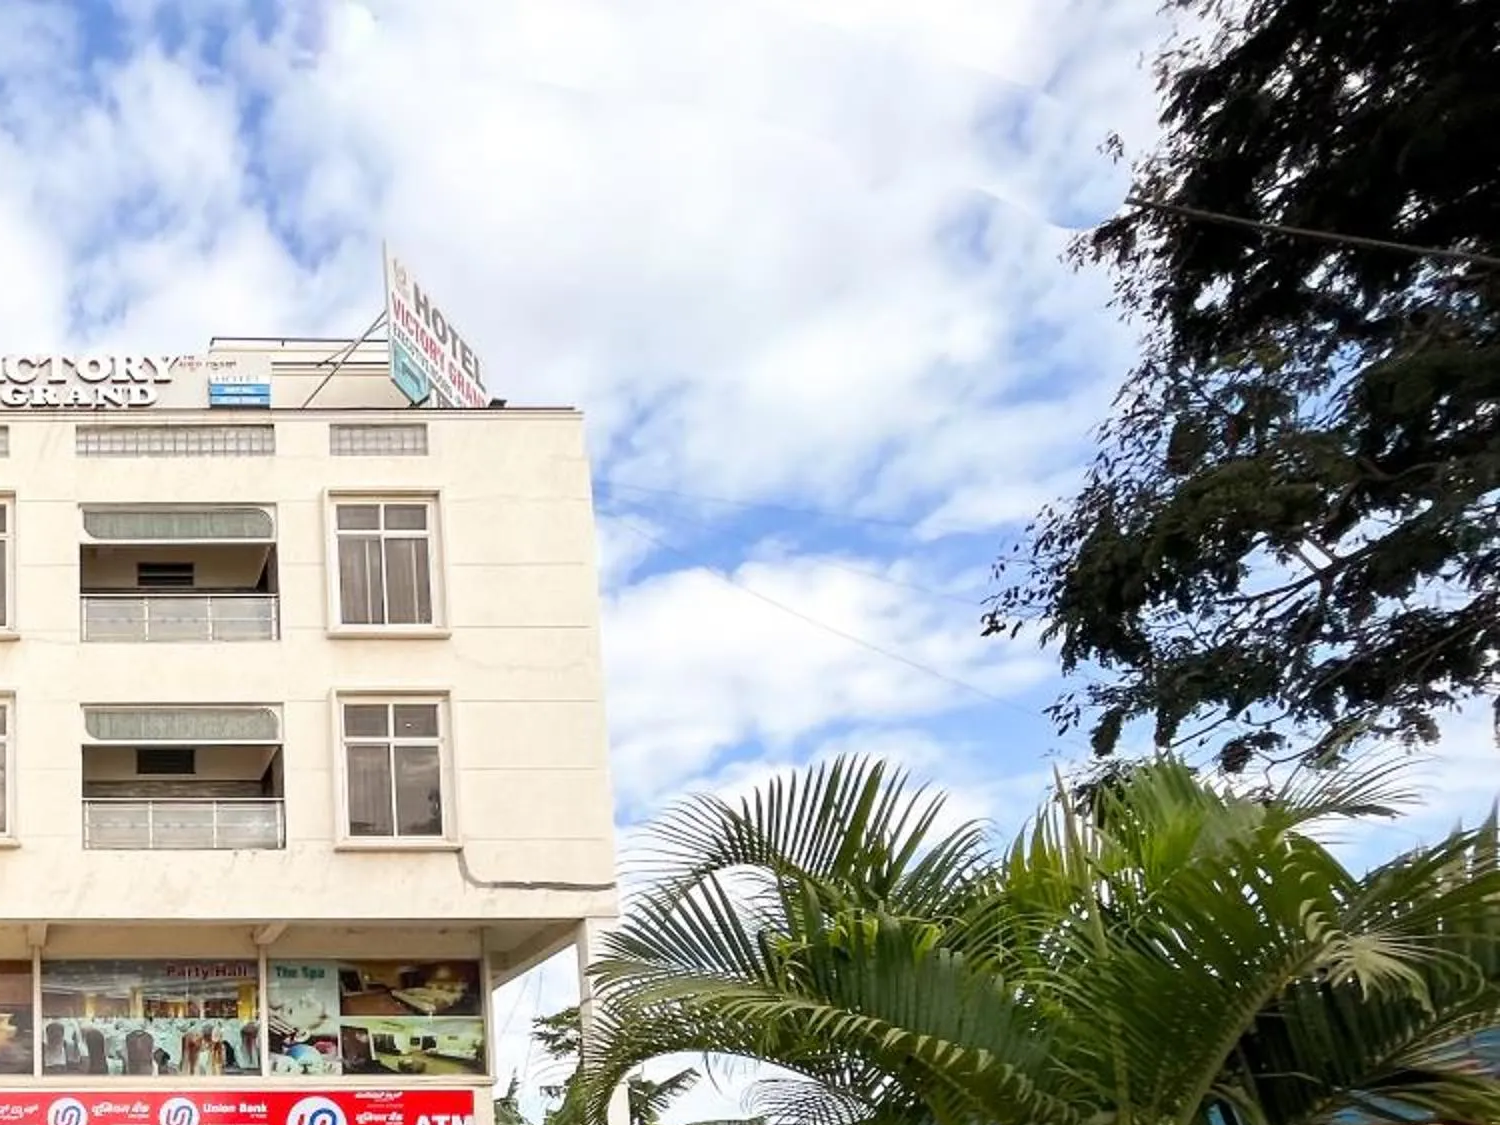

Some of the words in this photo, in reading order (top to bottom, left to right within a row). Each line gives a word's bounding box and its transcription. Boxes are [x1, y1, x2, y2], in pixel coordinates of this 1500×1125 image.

[392, 292, 445, 372] VICTORY
[413, 281, 486, 393] HOTEL
[0, 386, 158, 407] GRAND
[167, 965, 209, 979] Party
[215, 965, 248, 977] Hall
[276, 966, 298, 978] The
[302, 966, 325, 979] Spa
[203, 1103, 236, 1113] Union
[239, 1102, 267, 1113] Bank
